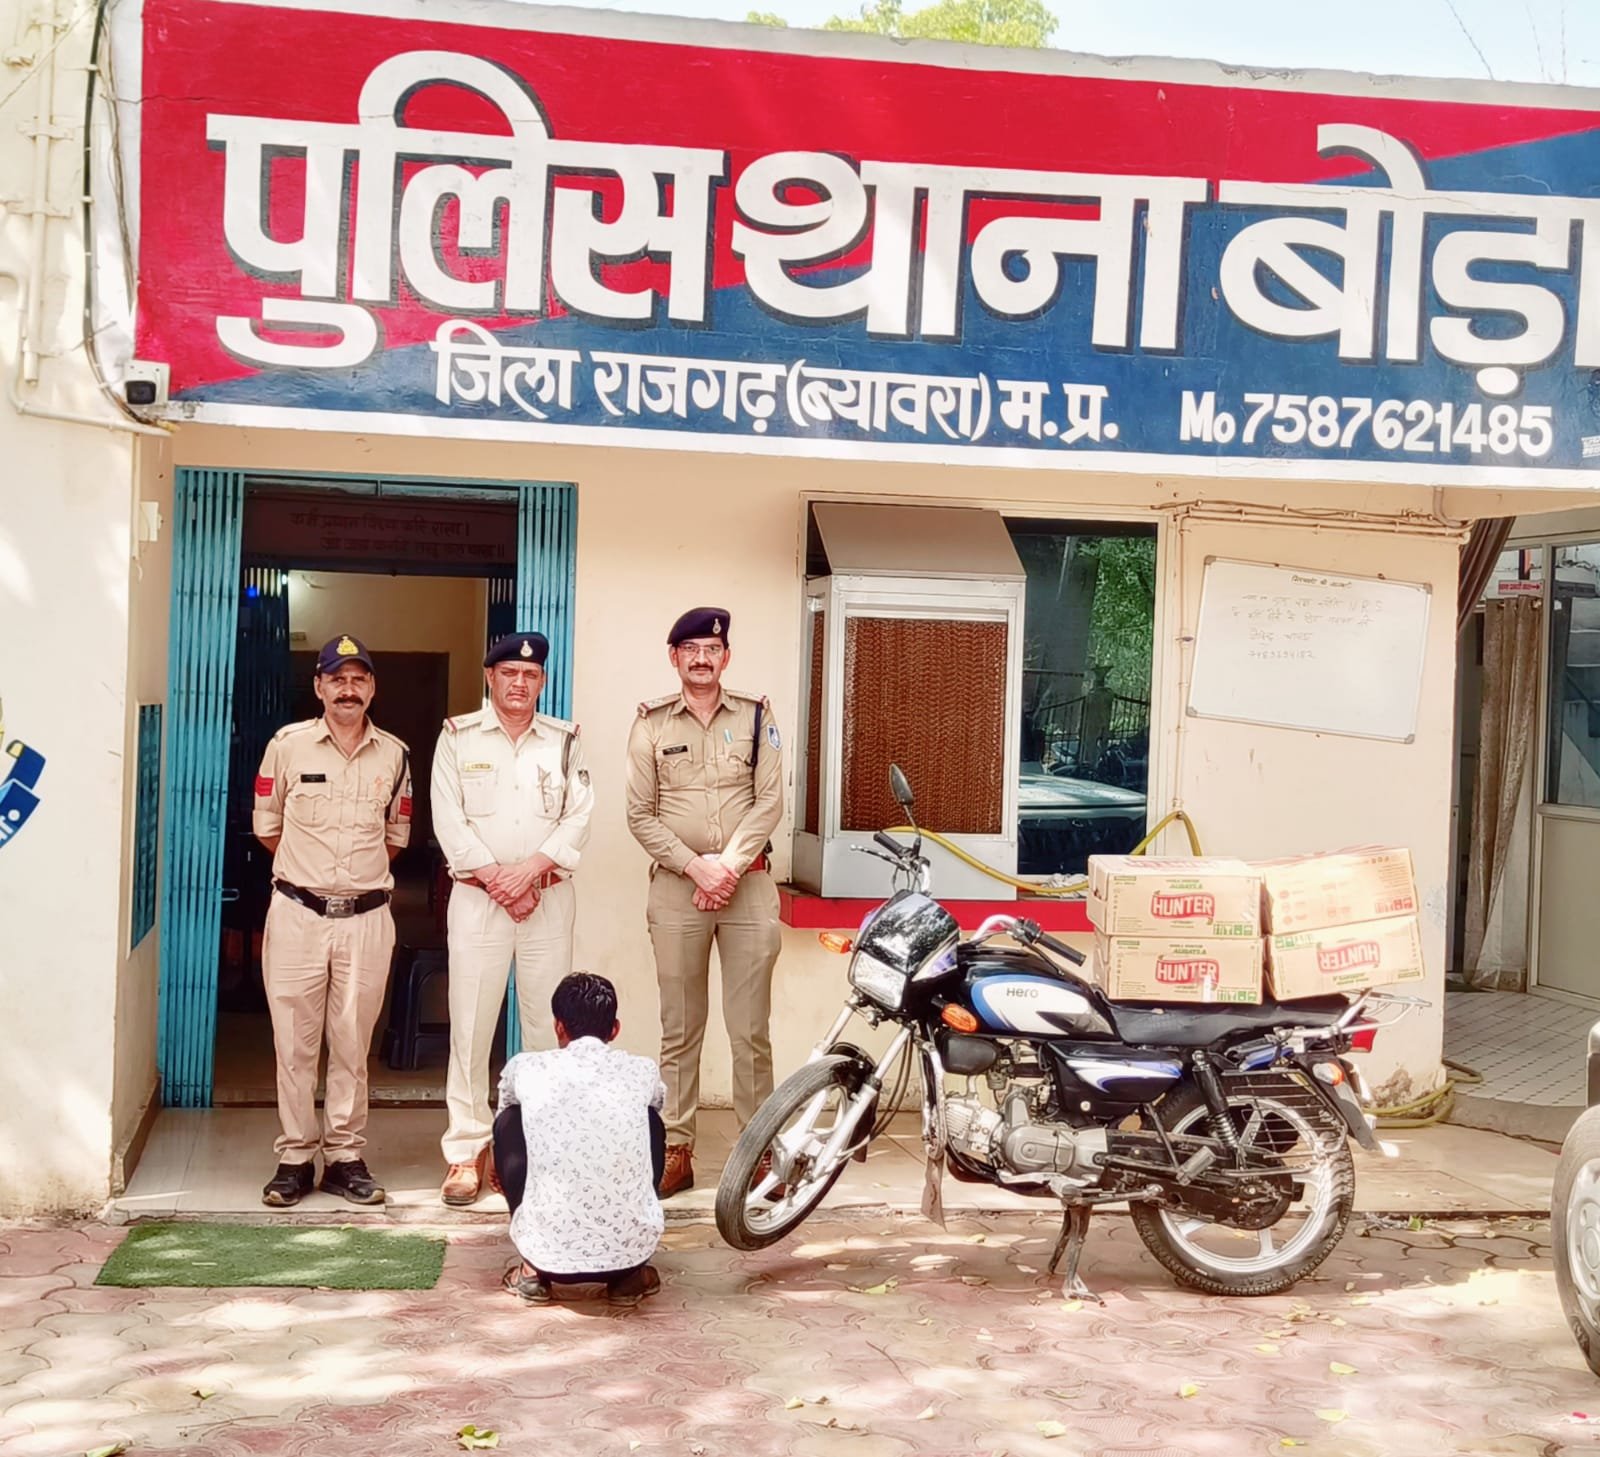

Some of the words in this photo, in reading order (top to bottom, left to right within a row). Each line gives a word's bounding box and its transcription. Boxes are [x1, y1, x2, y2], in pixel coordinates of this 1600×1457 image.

[206, 49, 722, 369] पुलिस
[732, 150, 1207, 352] थाना
[429, 319, 582, 420] जिला
[1179, 391, 1236, 443] Mo
[1242, 393, 1553, 457] 7587621485
[1153, 895, 1213, 917] HUNTER
[1319, 943, 1379, 970] HUNTER
[1157, 961, 1217, 982] HUNTER
[1006, 987, 1039, 998] Hero
